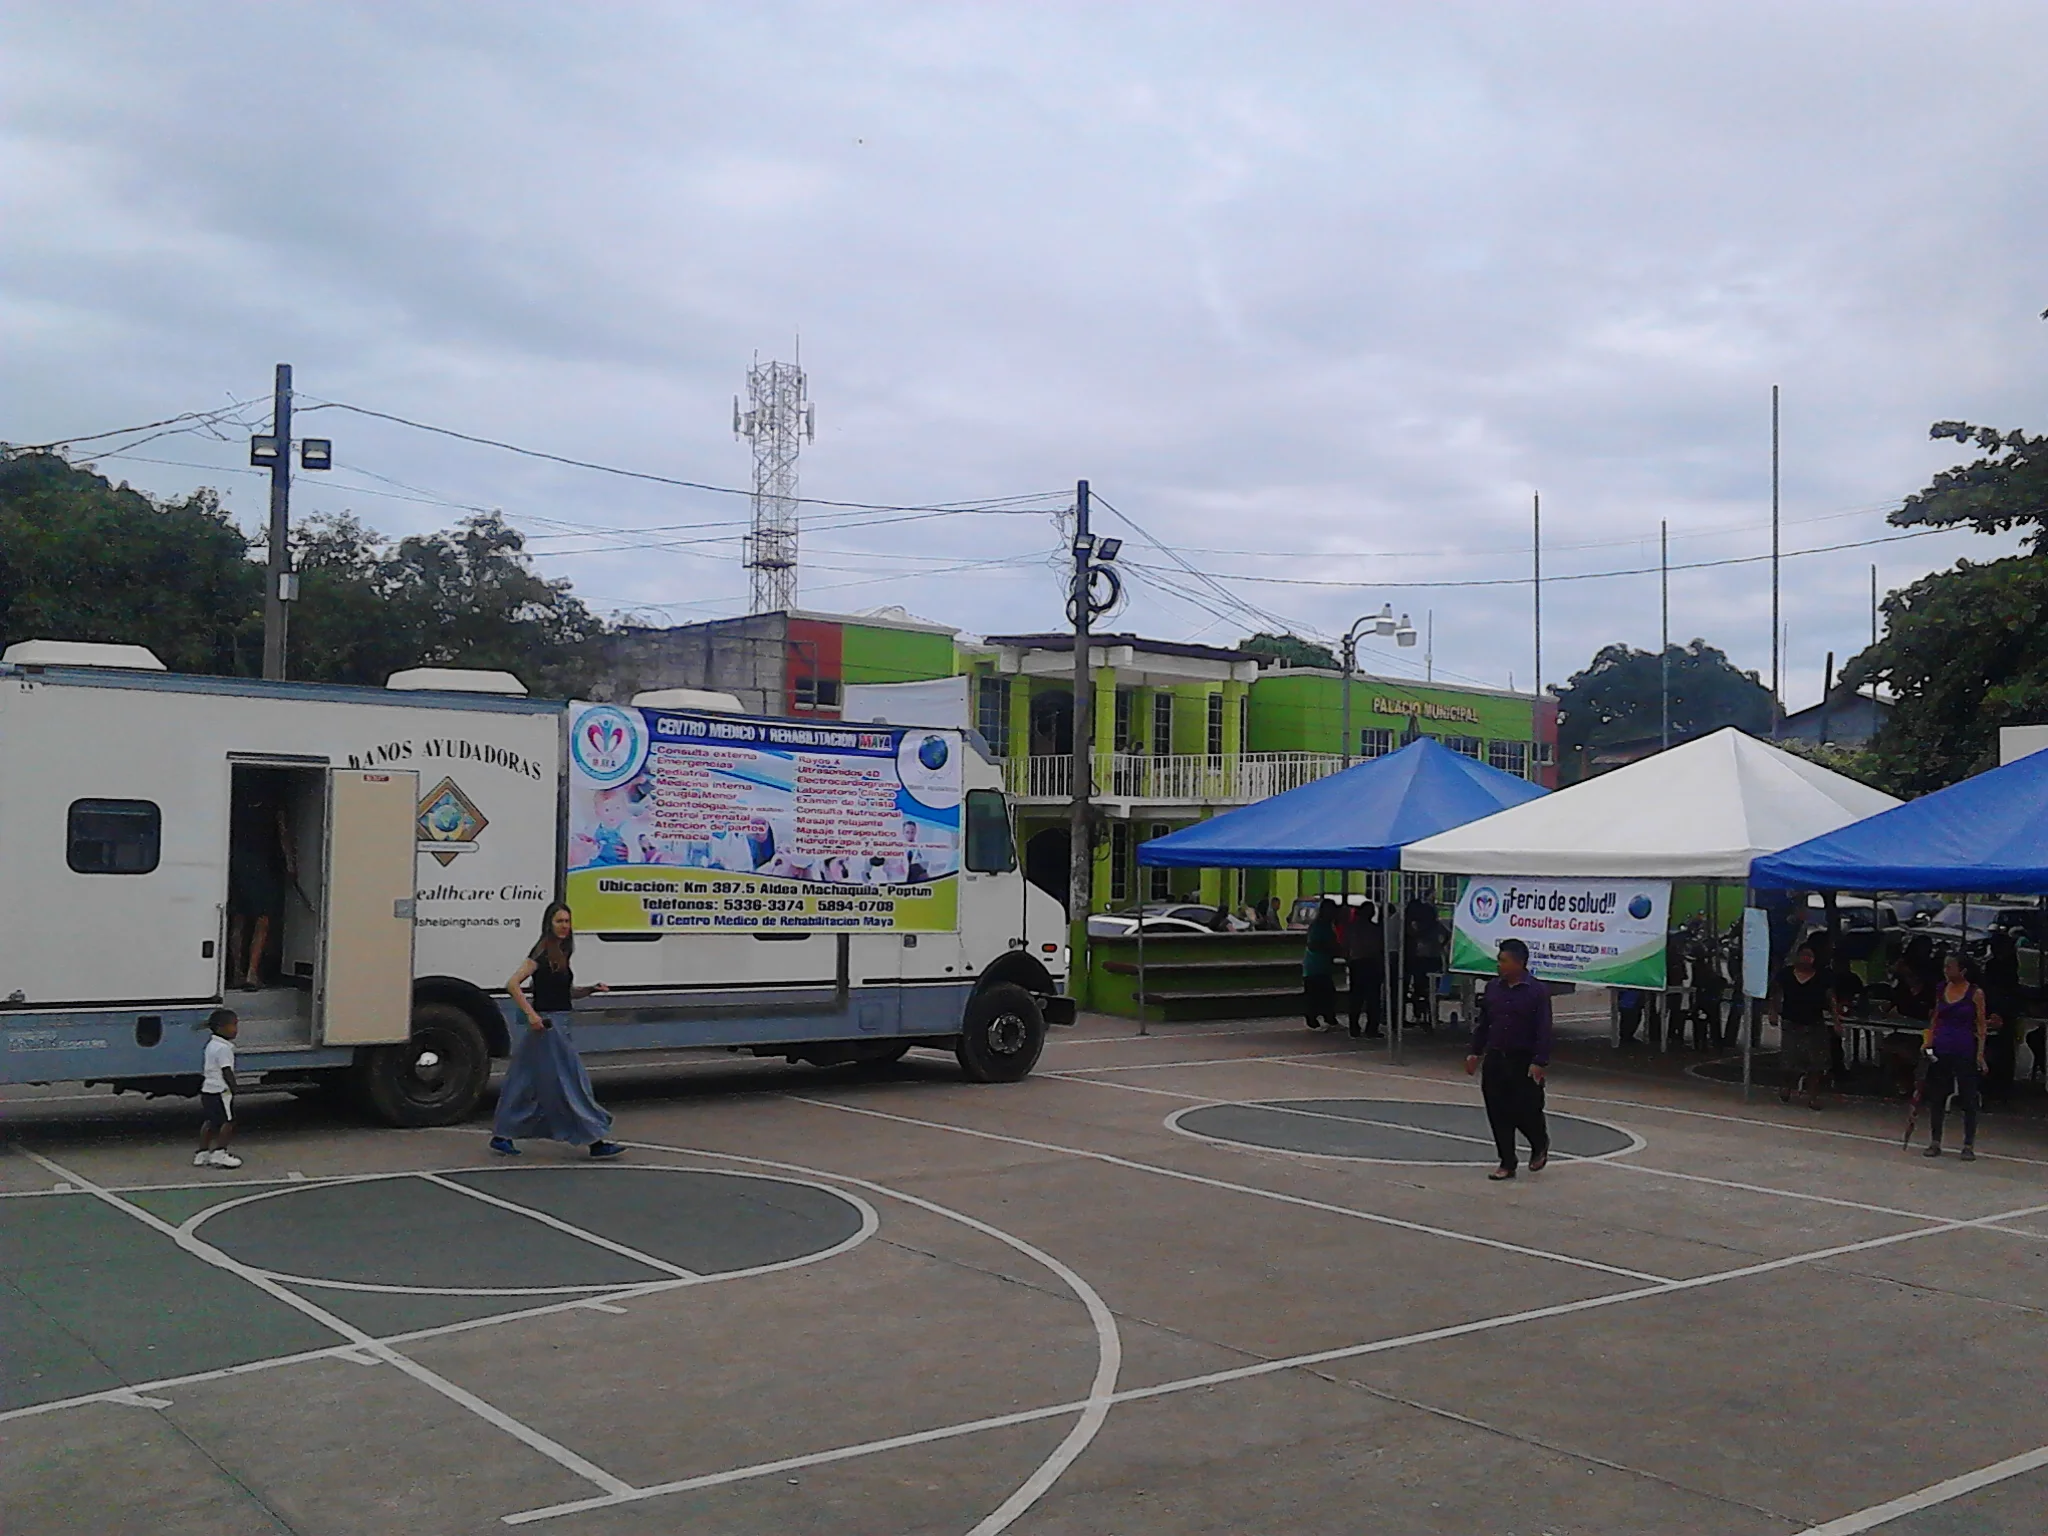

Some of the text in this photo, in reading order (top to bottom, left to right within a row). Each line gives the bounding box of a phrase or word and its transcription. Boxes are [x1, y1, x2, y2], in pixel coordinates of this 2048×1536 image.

[1372, 697, 1479, 723] PALACIO MUNICIPAL
[657, 718, 706, 737] CENTRO
[758, 727, 766, 742] Y
[858, 733, 892, 751] MAYA
[422, 739, 541, 781] AYUDADORAS
[713, 750, 757, 761] externa
[866, 770, 880, 778] 4D
[712, 780, 752, 791] interna
[702, 789, 737, 800] Menor
[841, 798, 854, 806] de
[857, 798, 867, 807] la
[870, 799, 895, 808] vista
[702, 812, 750, 823] prenatal
[846, 809, 901, 818] Nutricional
[710, 822, 724, 831] de
[728, 823, 765, 834] partos
[838, 818, 883, 828] relajante
[873, 841, 903, 849] sauna
[861, 849, 874, 858] de
[416, 885, 546, 901] ealthcare Clinic
[684, 882, 707, 894] Km
[712, 882, 755, 894] 387.5
[760, 883, 797, 895] Aldea
[724, 899, 804, 912] 5336-3374
[818, 900, 894, 912] 5894-0708
[1549, 889, 1565, 912] de
[1568, 891, 1616, 915] salud!!
[667, 915, 710, 926] Centro
[762, 916, 776, 926] de
[863, 916, 894, 928] Maya
[1510, 914, 1566, 930] Consultas
[1569, 917, 1605, 933] Gratis
